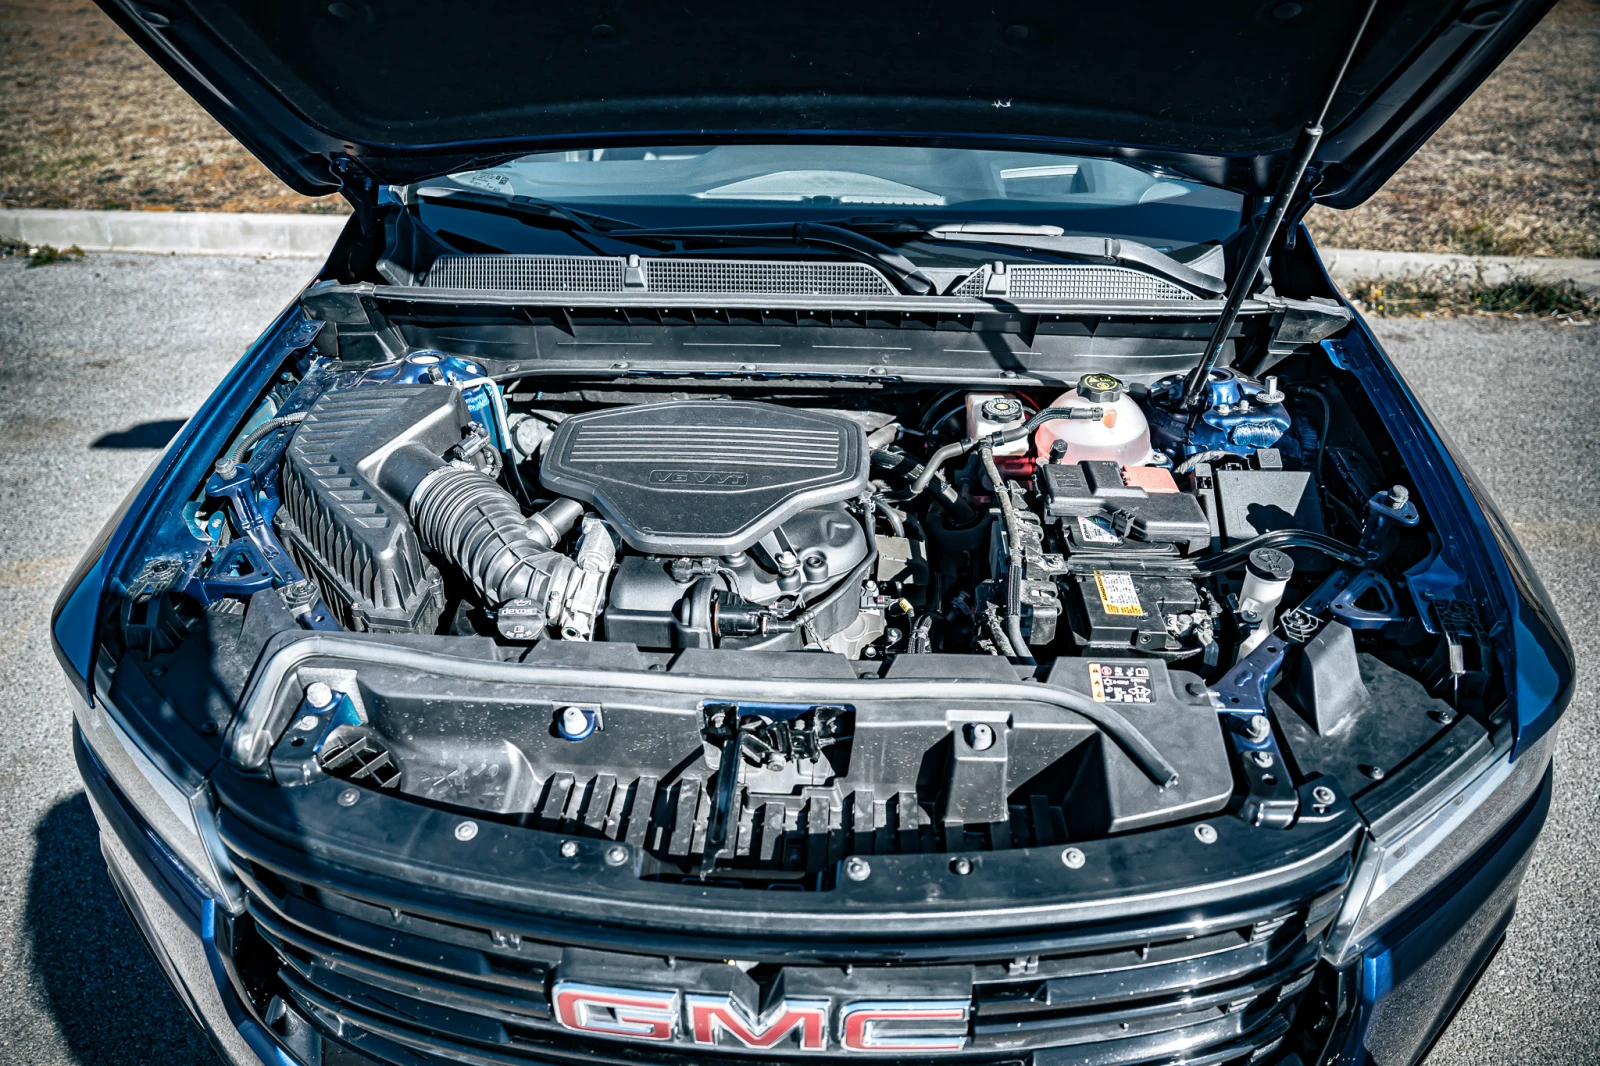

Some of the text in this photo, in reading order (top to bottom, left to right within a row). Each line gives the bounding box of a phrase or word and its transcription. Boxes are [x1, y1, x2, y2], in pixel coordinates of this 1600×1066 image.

[655, 472, 744, 484] V6 VVT
[552, 980, 971, 1052] GMC
